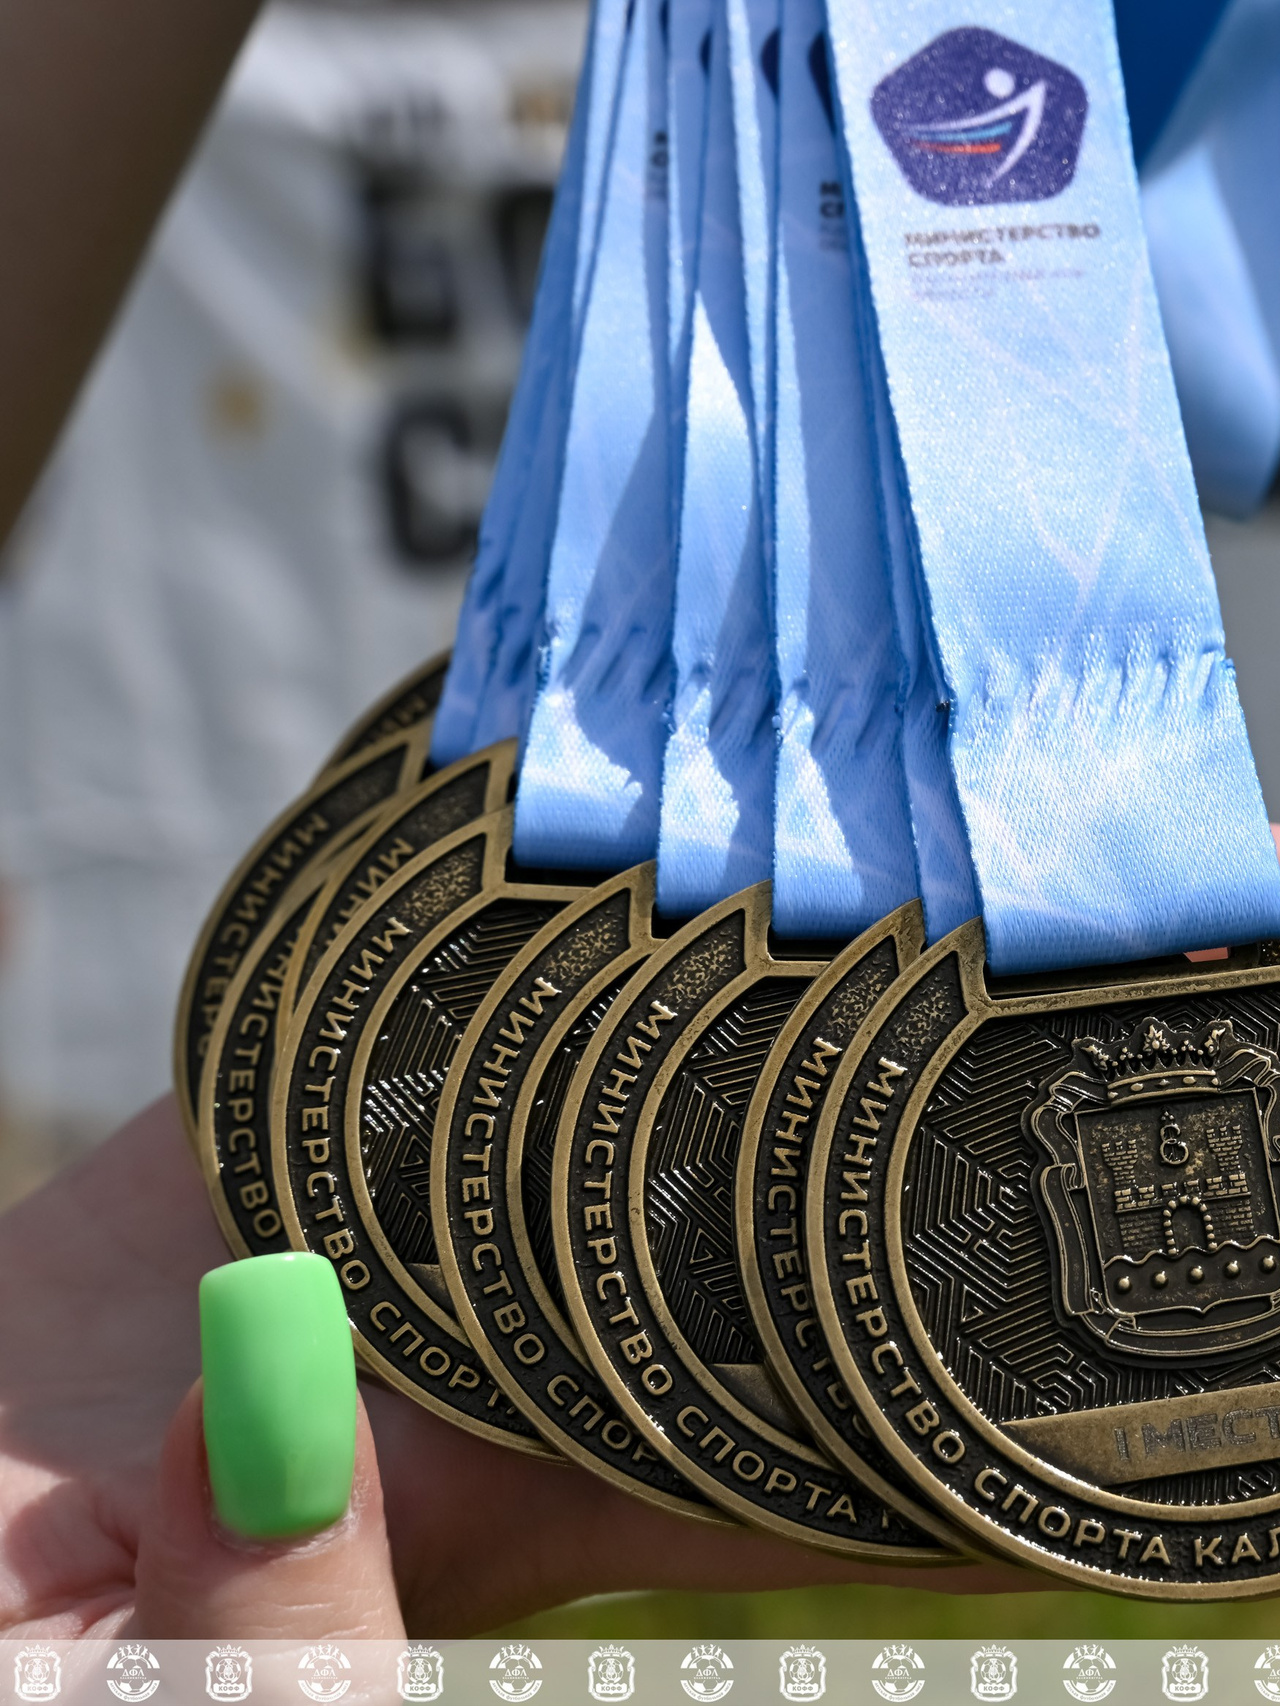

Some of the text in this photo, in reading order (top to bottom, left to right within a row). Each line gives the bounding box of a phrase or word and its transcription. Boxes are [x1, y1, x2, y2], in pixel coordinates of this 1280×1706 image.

[302, 916, 412, 1290] МИНИСТЕРСТВО
[462, 977, 562, 1365] МИНИСТЕРСТВО
[584, 1000, 857, 1524] МИНИСТЕРСТВО СПОРТА
[838, 1056, 965, 1464] МИНИСТЕРСТВО
[974, 1465, 1171, 1566] СПОРТА
